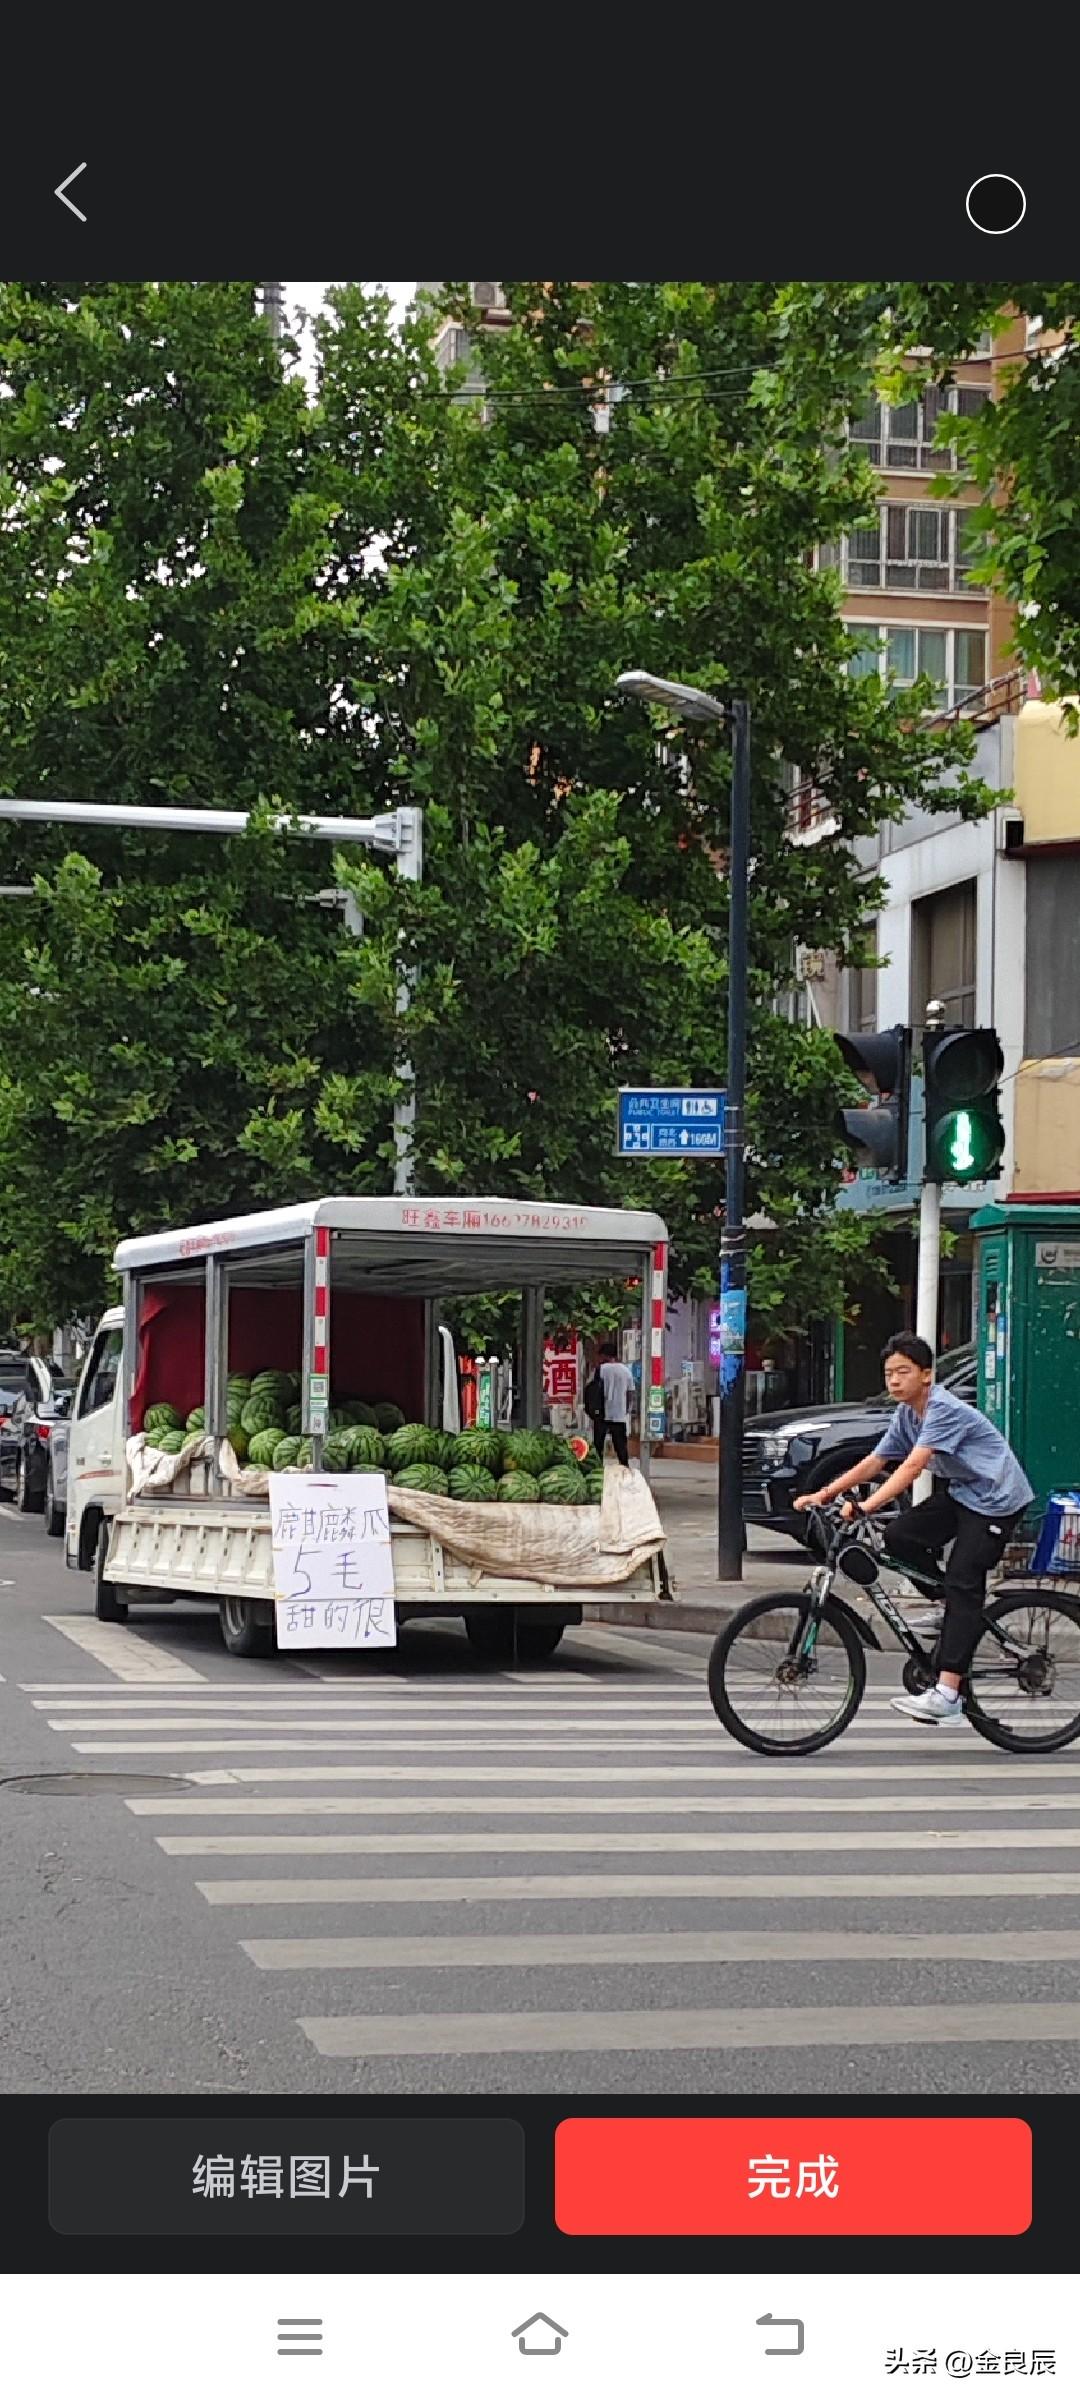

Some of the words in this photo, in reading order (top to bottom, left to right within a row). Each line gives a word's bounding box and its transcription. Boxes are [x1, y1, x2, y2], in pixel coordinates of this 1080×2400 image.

[274, 1502, 389, 1543] 麒麟瓜
[286, 1598, 390, 1639] 甜的很
